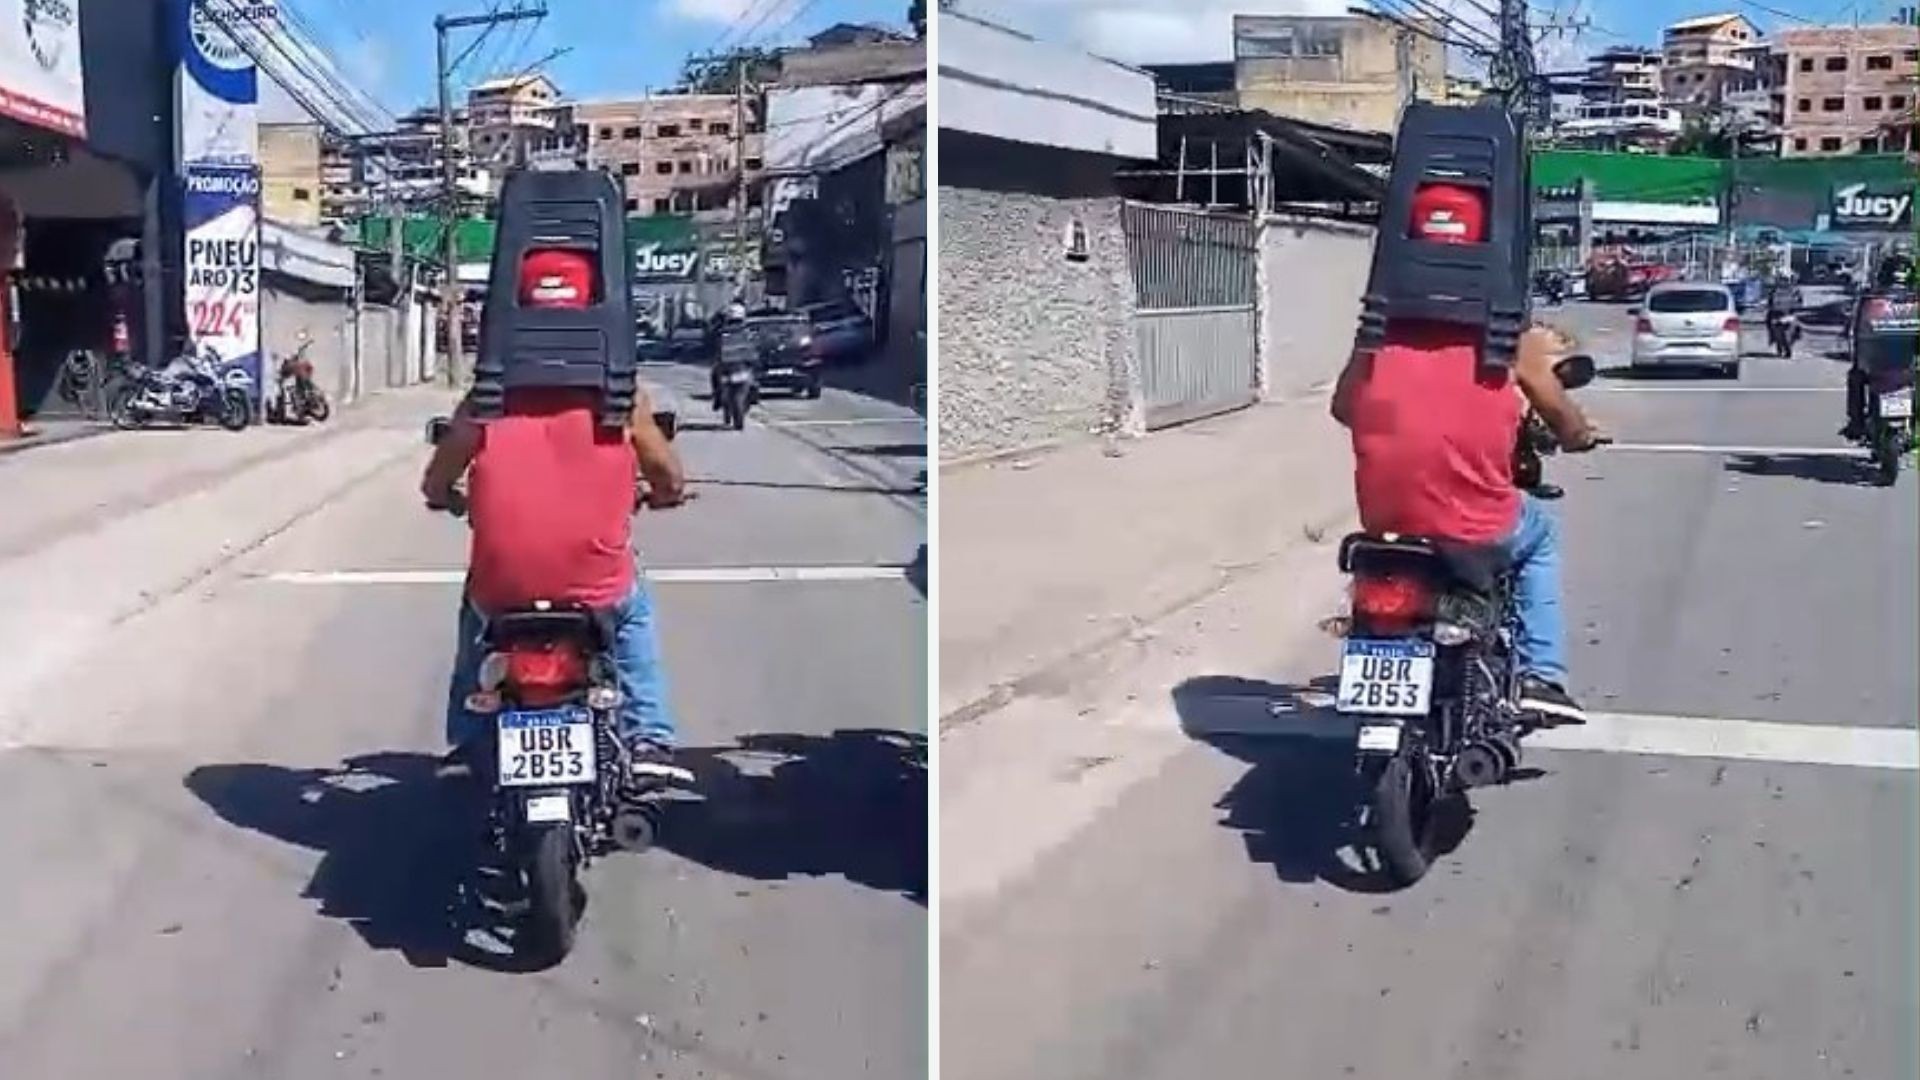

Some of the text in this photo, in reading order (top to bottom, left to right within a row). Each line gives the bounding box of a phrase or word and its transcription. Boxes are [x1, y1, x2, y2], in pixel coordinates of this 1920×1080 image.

[188, 175, 259, 197] PROMOÇÃO
[1836, 183, 1910, 224] Jucy
[189, 238, 255, 267] PNEU
[636, 241, 698, 276] Jucy
[189, 269, 255, 294] ARO 13
[1362, 657, 1412, 681] UBR
[1350, 682, 1419, 707] 2B53
[520, 727, 573, 752] UBR
[513, 752, 584, 778] 2B53
